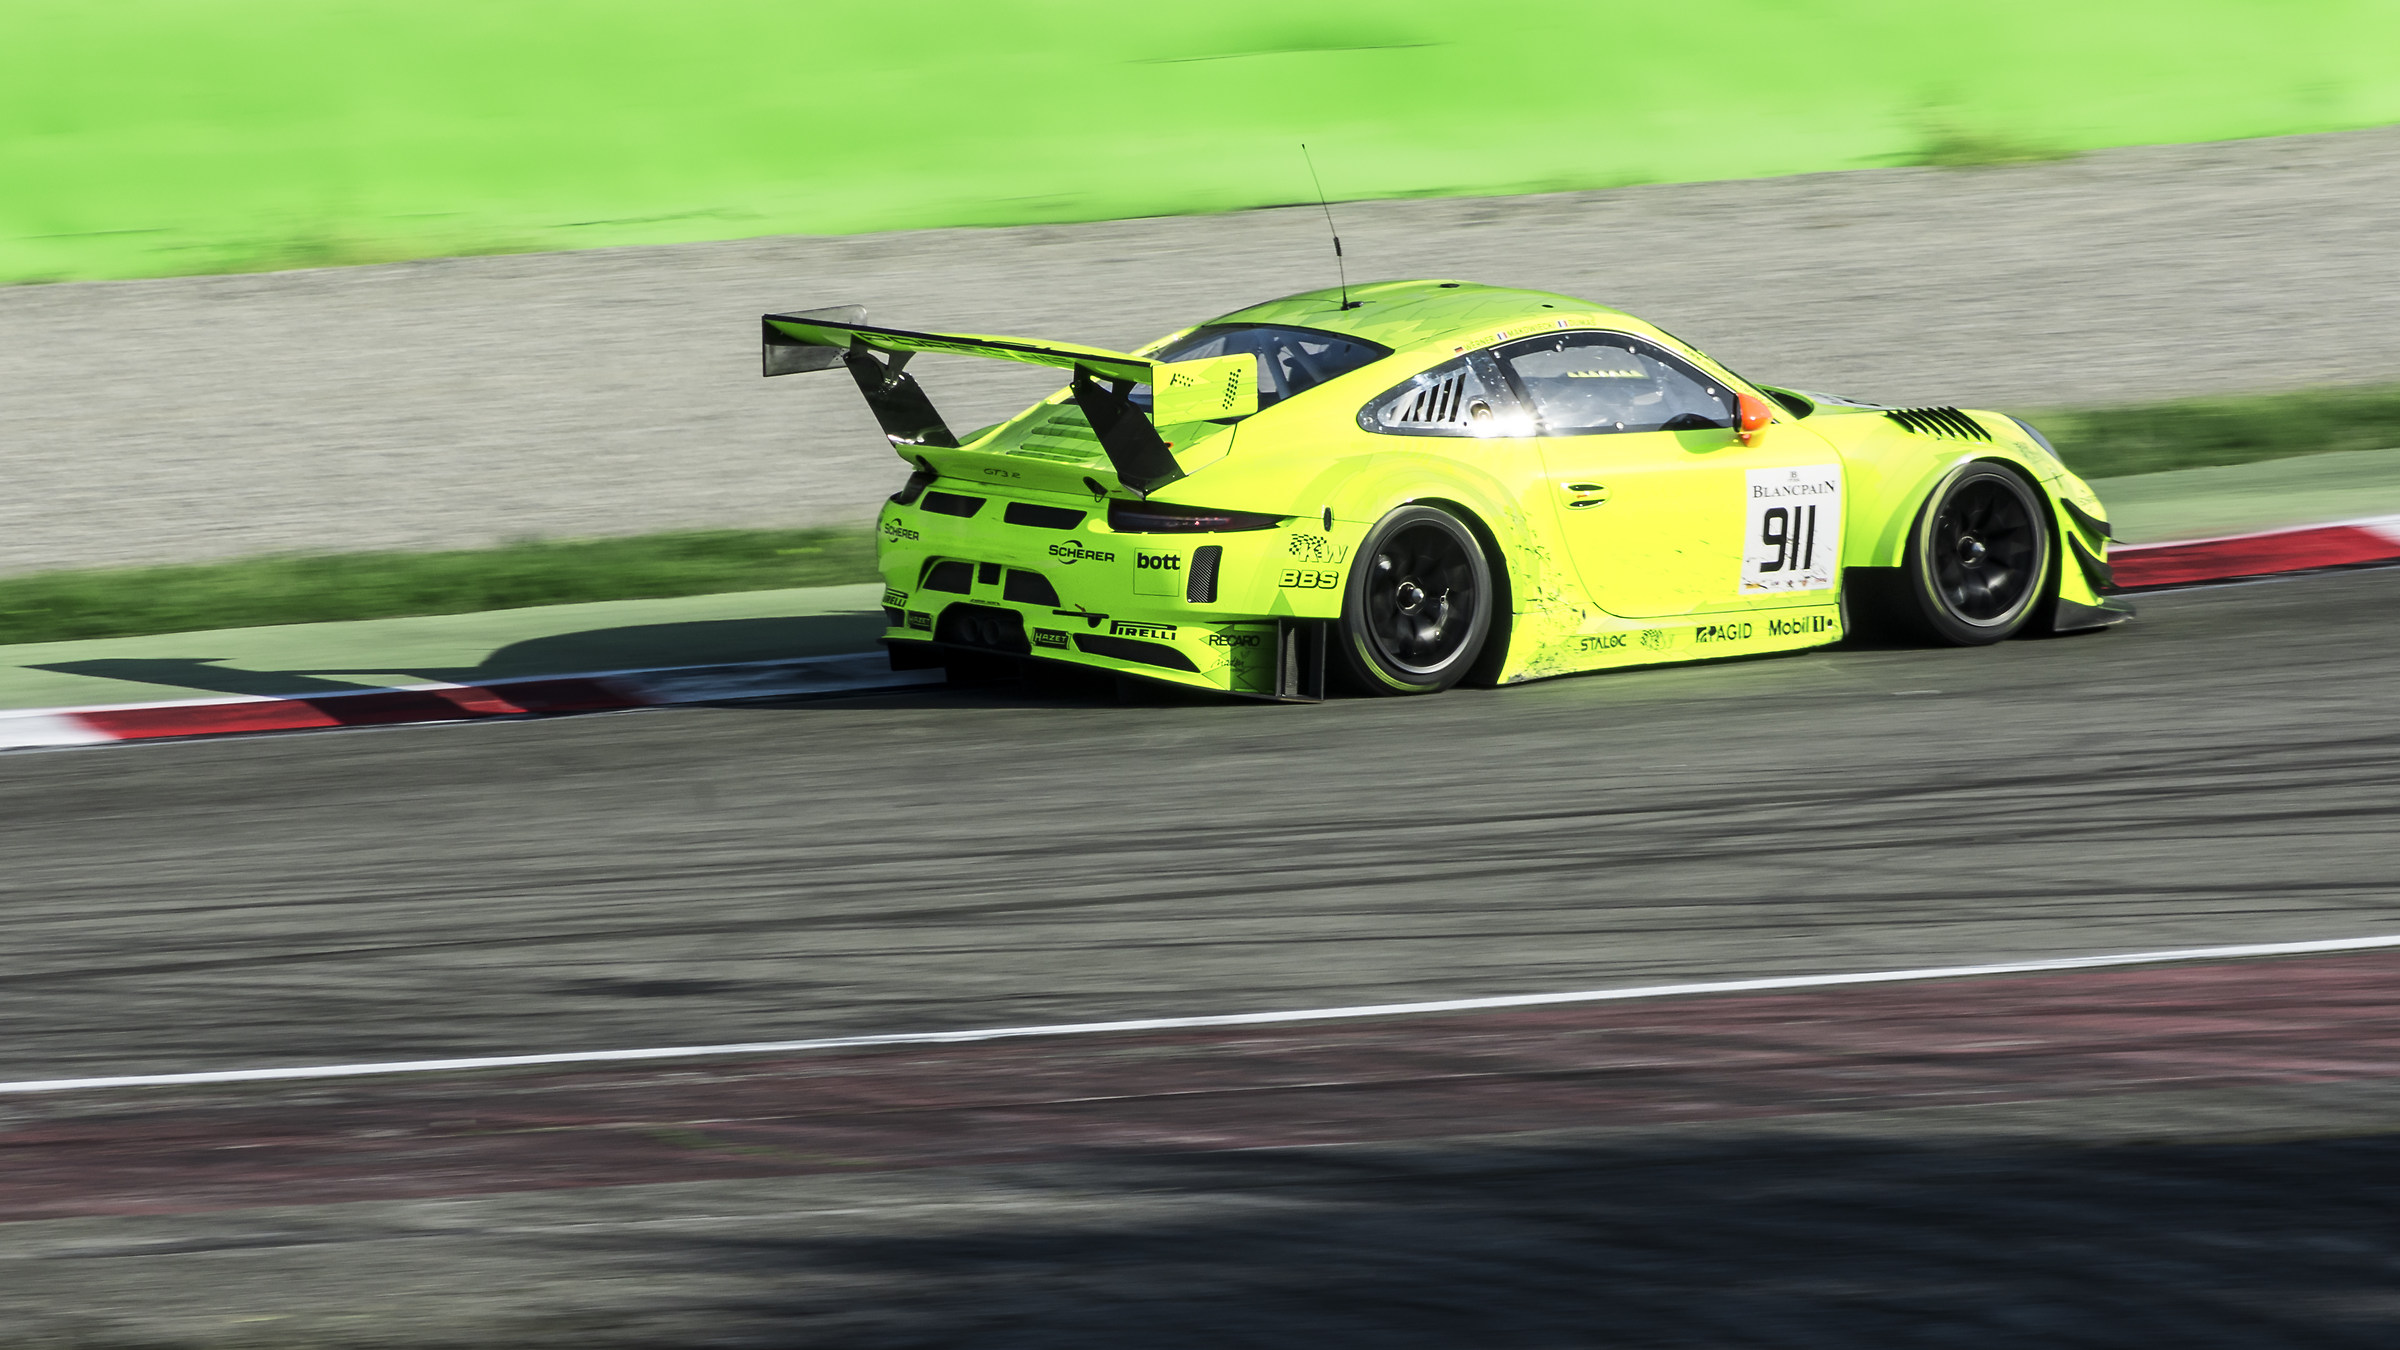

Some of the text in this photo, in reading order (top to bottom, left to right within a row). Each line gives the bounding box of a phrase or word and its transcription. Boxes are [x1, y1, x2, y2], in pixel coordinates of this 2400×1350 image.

[983, 468, 1009, 478] GT3
[1753, 480, 1835, 498] BLANCPAIN
[884, 522, 920, 541] SCHERER
[1759, 504, 1816, 573] 911
[1048, 544, 1115, 562] SCHERER
[1136, 552, 1180, 571] bott
[1298, 543, 1348, 564] KW
[1278, 568, 1339, 589] BBS
[1109, 620, 1177, 641] PIRELLI
[1708, 622, 1753, 642] PAGID
[1768, 616, 1809, 637] Mobil
[1034, 632, 1067, 644] HAZET
[1209, 634, 1260, 647] RECARO
[1580, 634, 1627, 652] STALOC
